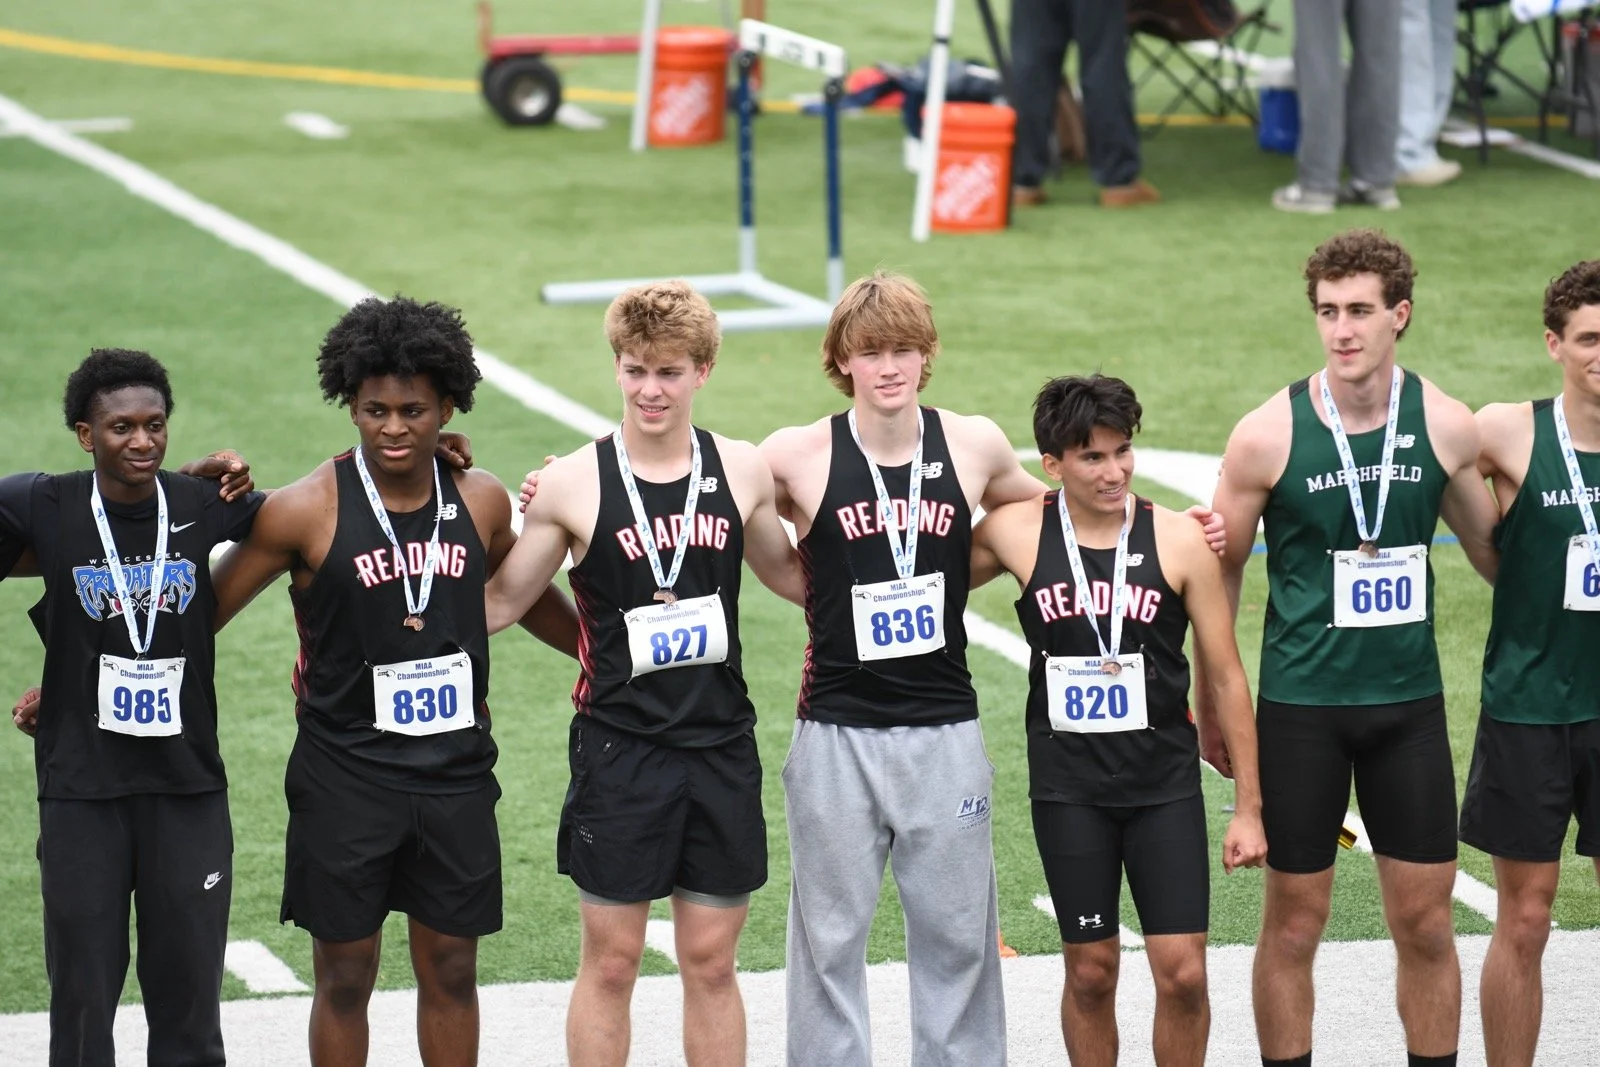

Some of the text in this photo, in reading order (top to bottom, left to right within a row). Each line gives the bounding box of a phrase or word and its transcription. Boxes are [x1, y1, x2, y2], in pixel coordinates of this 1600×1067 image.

[1306, 464, 1422, 493] MARHFELD
[836, 498, 955, 541] READNG
[89, 551, 181, 565] WOCESER
[873, 588, 926, 603] Championships
[890, 582, 908, 592] MIAA
[1035, 580, 1161, 623] READNG
[1352, 575, 1411, 614] 660
[646, 608, 700, 624] Championships
[870, 604, 936, 647] 836
[650, 624, 708, 666] 827
[120, 669, 166, 681] Championships
[136, 663, 155, 672] MIAA
[397, 668, 451, 681] Championships
[415, 661, 433, 671] MIAA
[112, 686, 172, 724] 985
[393, 684, 458, 725] 830
[1064, 684, 1129, 721] 820
